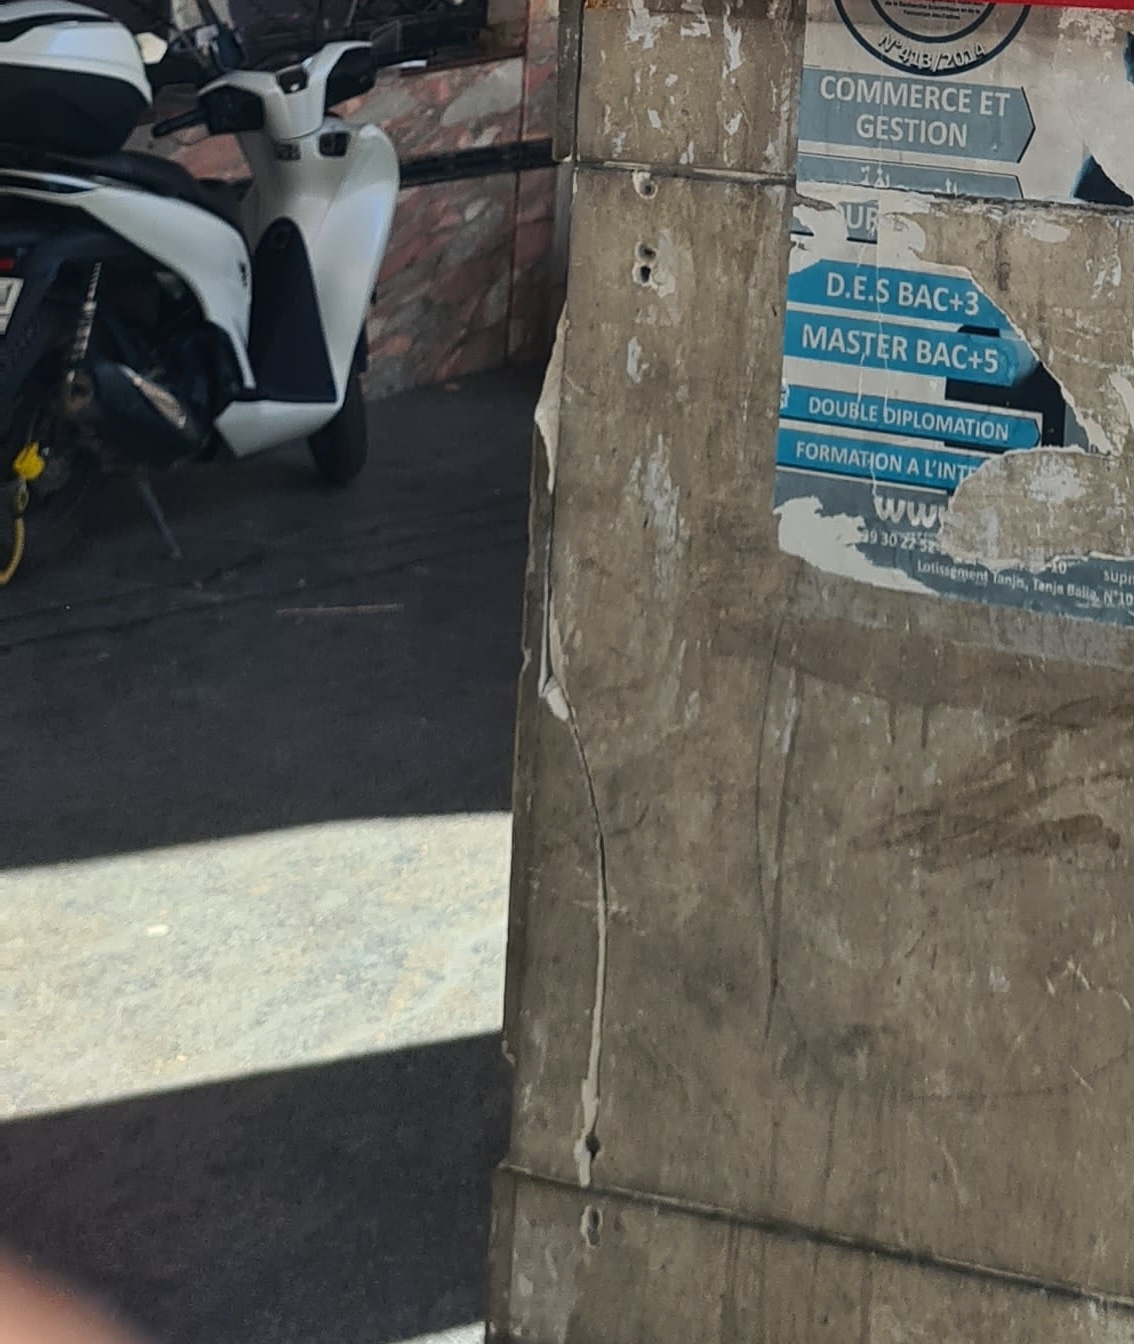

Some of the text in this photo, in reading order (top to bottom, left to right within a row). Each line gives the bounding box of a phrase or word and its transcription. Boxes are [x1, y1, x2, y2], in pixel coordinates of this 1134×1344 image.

[820, 75, 1011, 117] COMMERCE ET
[856, 114, 967, 148] GESTION
[826, 271, 980, 317] D.E.S BAC+3
[802, 323, 999, 374] MASTER BAC+5
[808, 395, 1010, 442] DOUBLE DIPLOMATION
[796, 440, 902, 472] FORMATION
[907, 461, 919, 476] A
